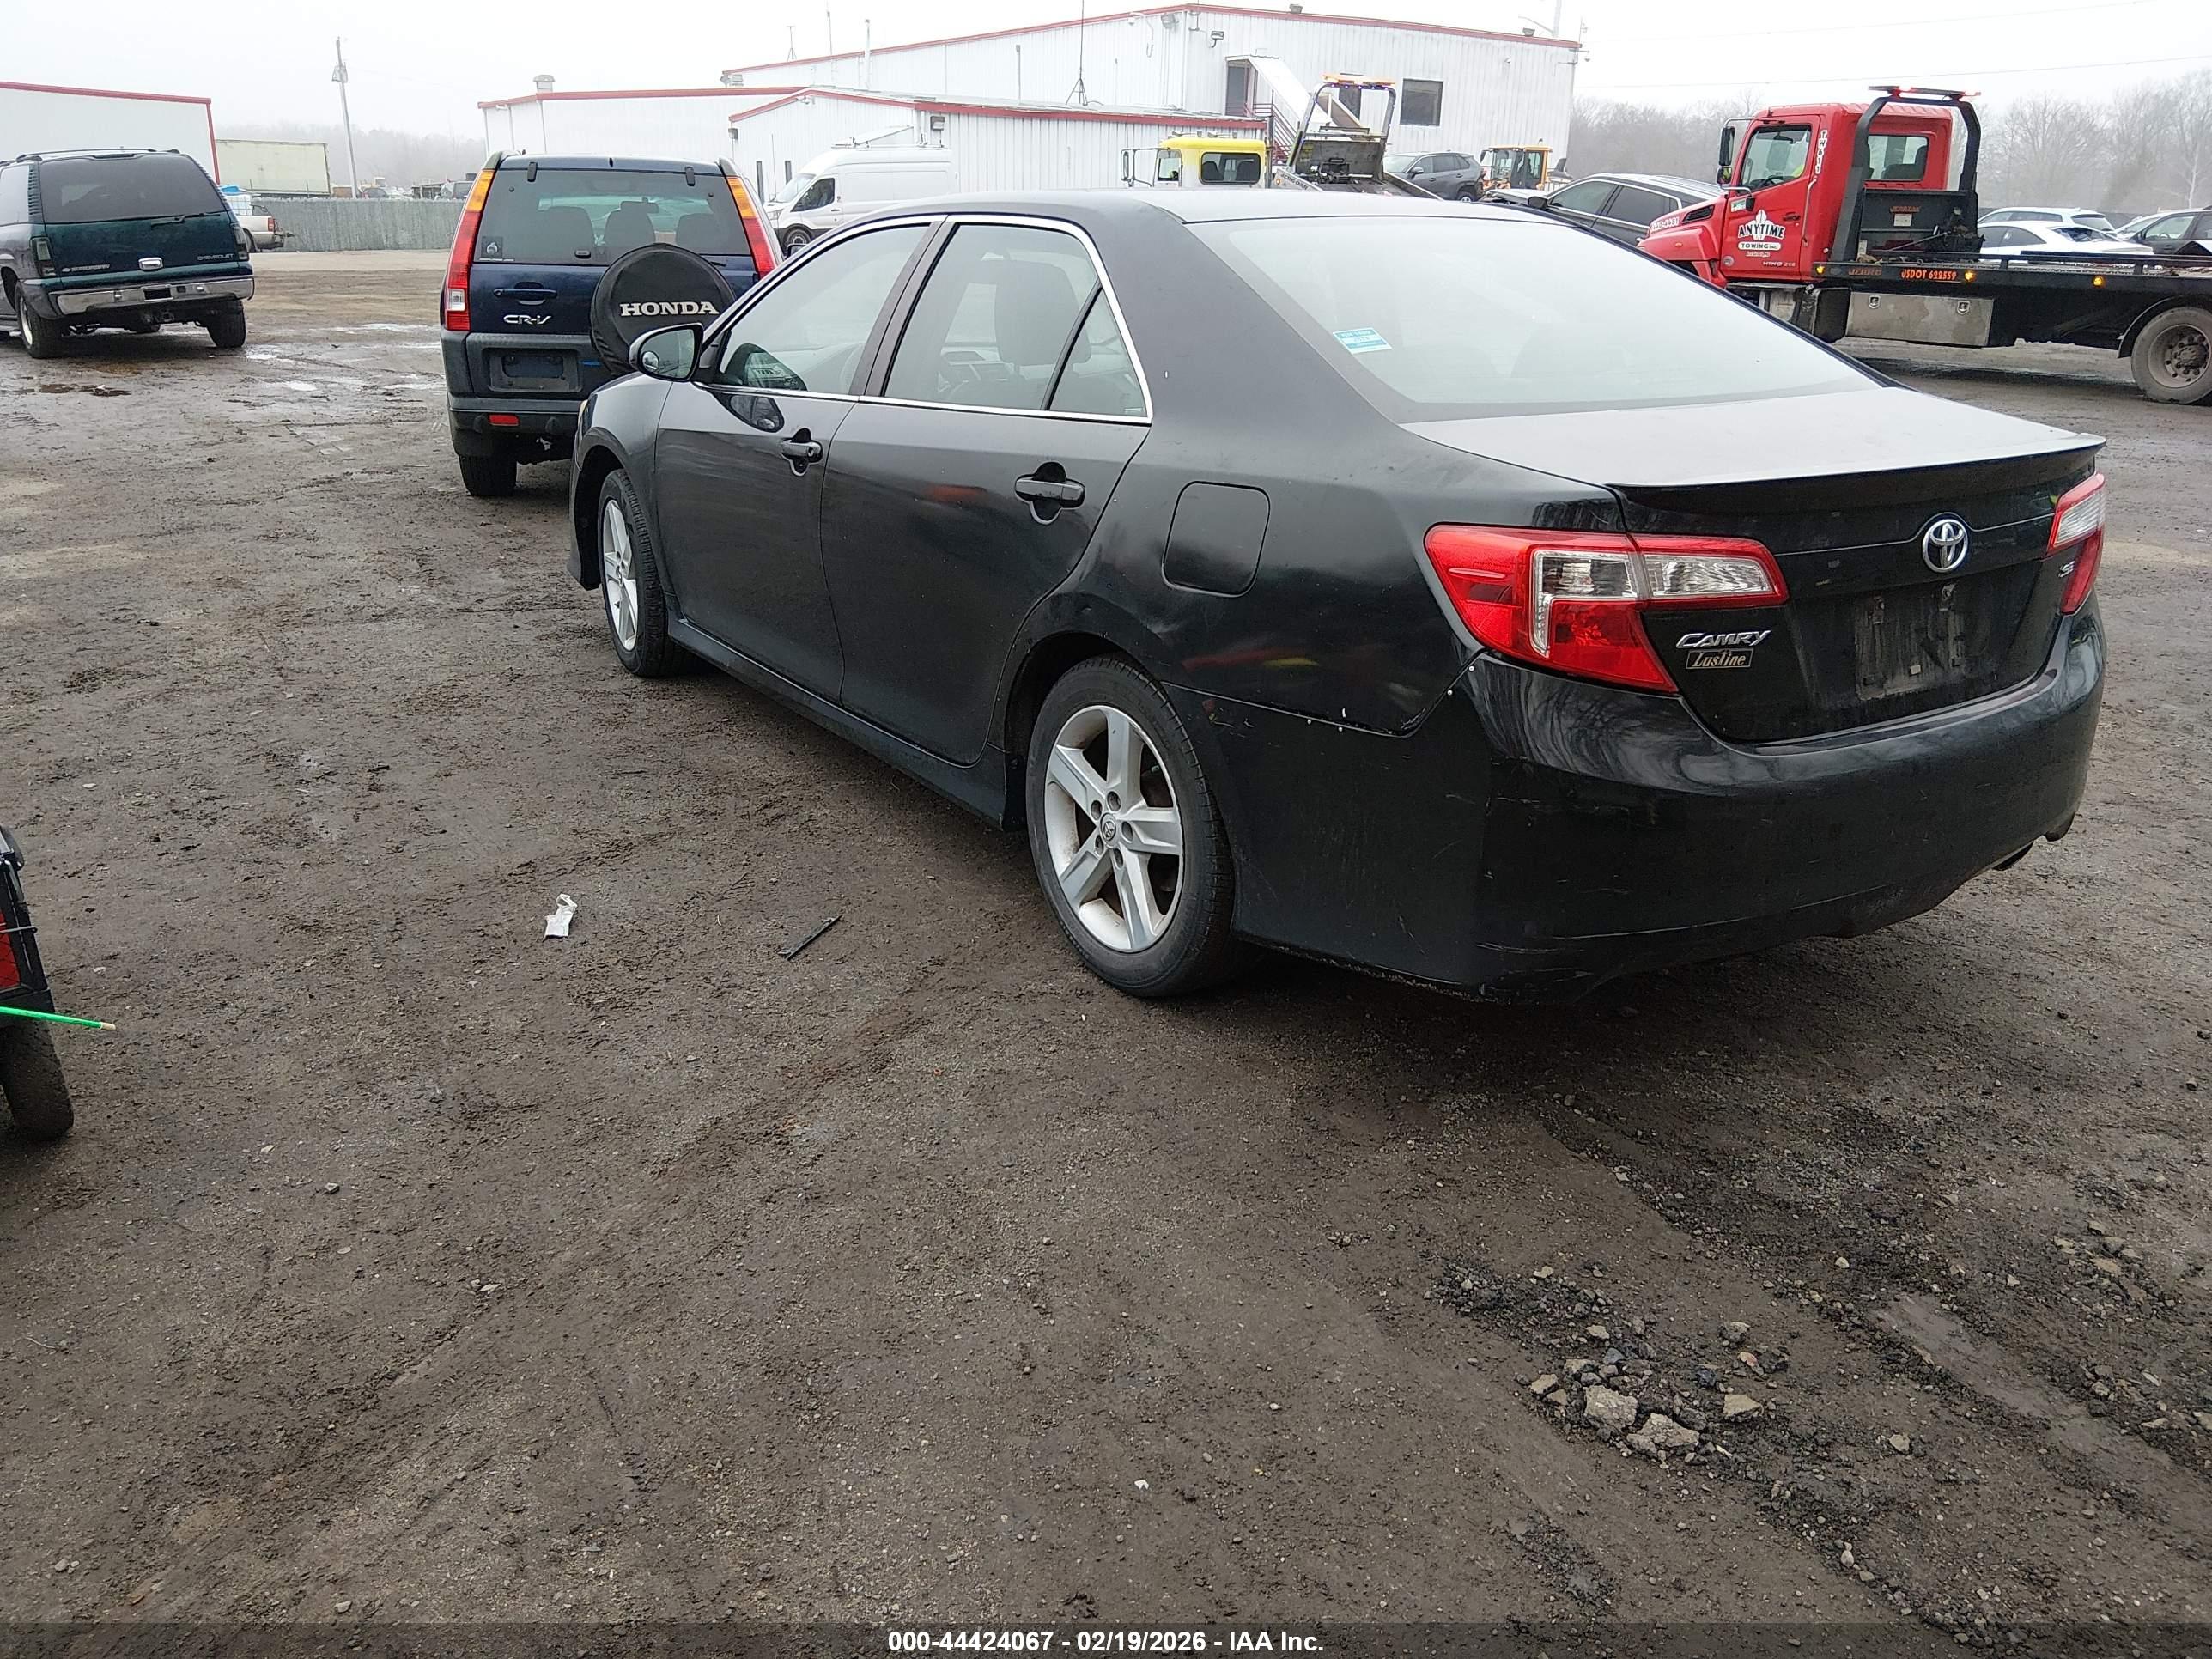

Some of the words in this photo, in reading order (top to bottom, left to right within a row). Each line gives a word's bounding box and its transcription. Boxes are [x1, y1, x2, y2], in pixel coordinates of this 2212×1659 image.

[1738, 223, 1785, 240] ANYTIME
[619, 301, 720, 317] HONDA
[1675, 630, 1771, 649] CAMRY
